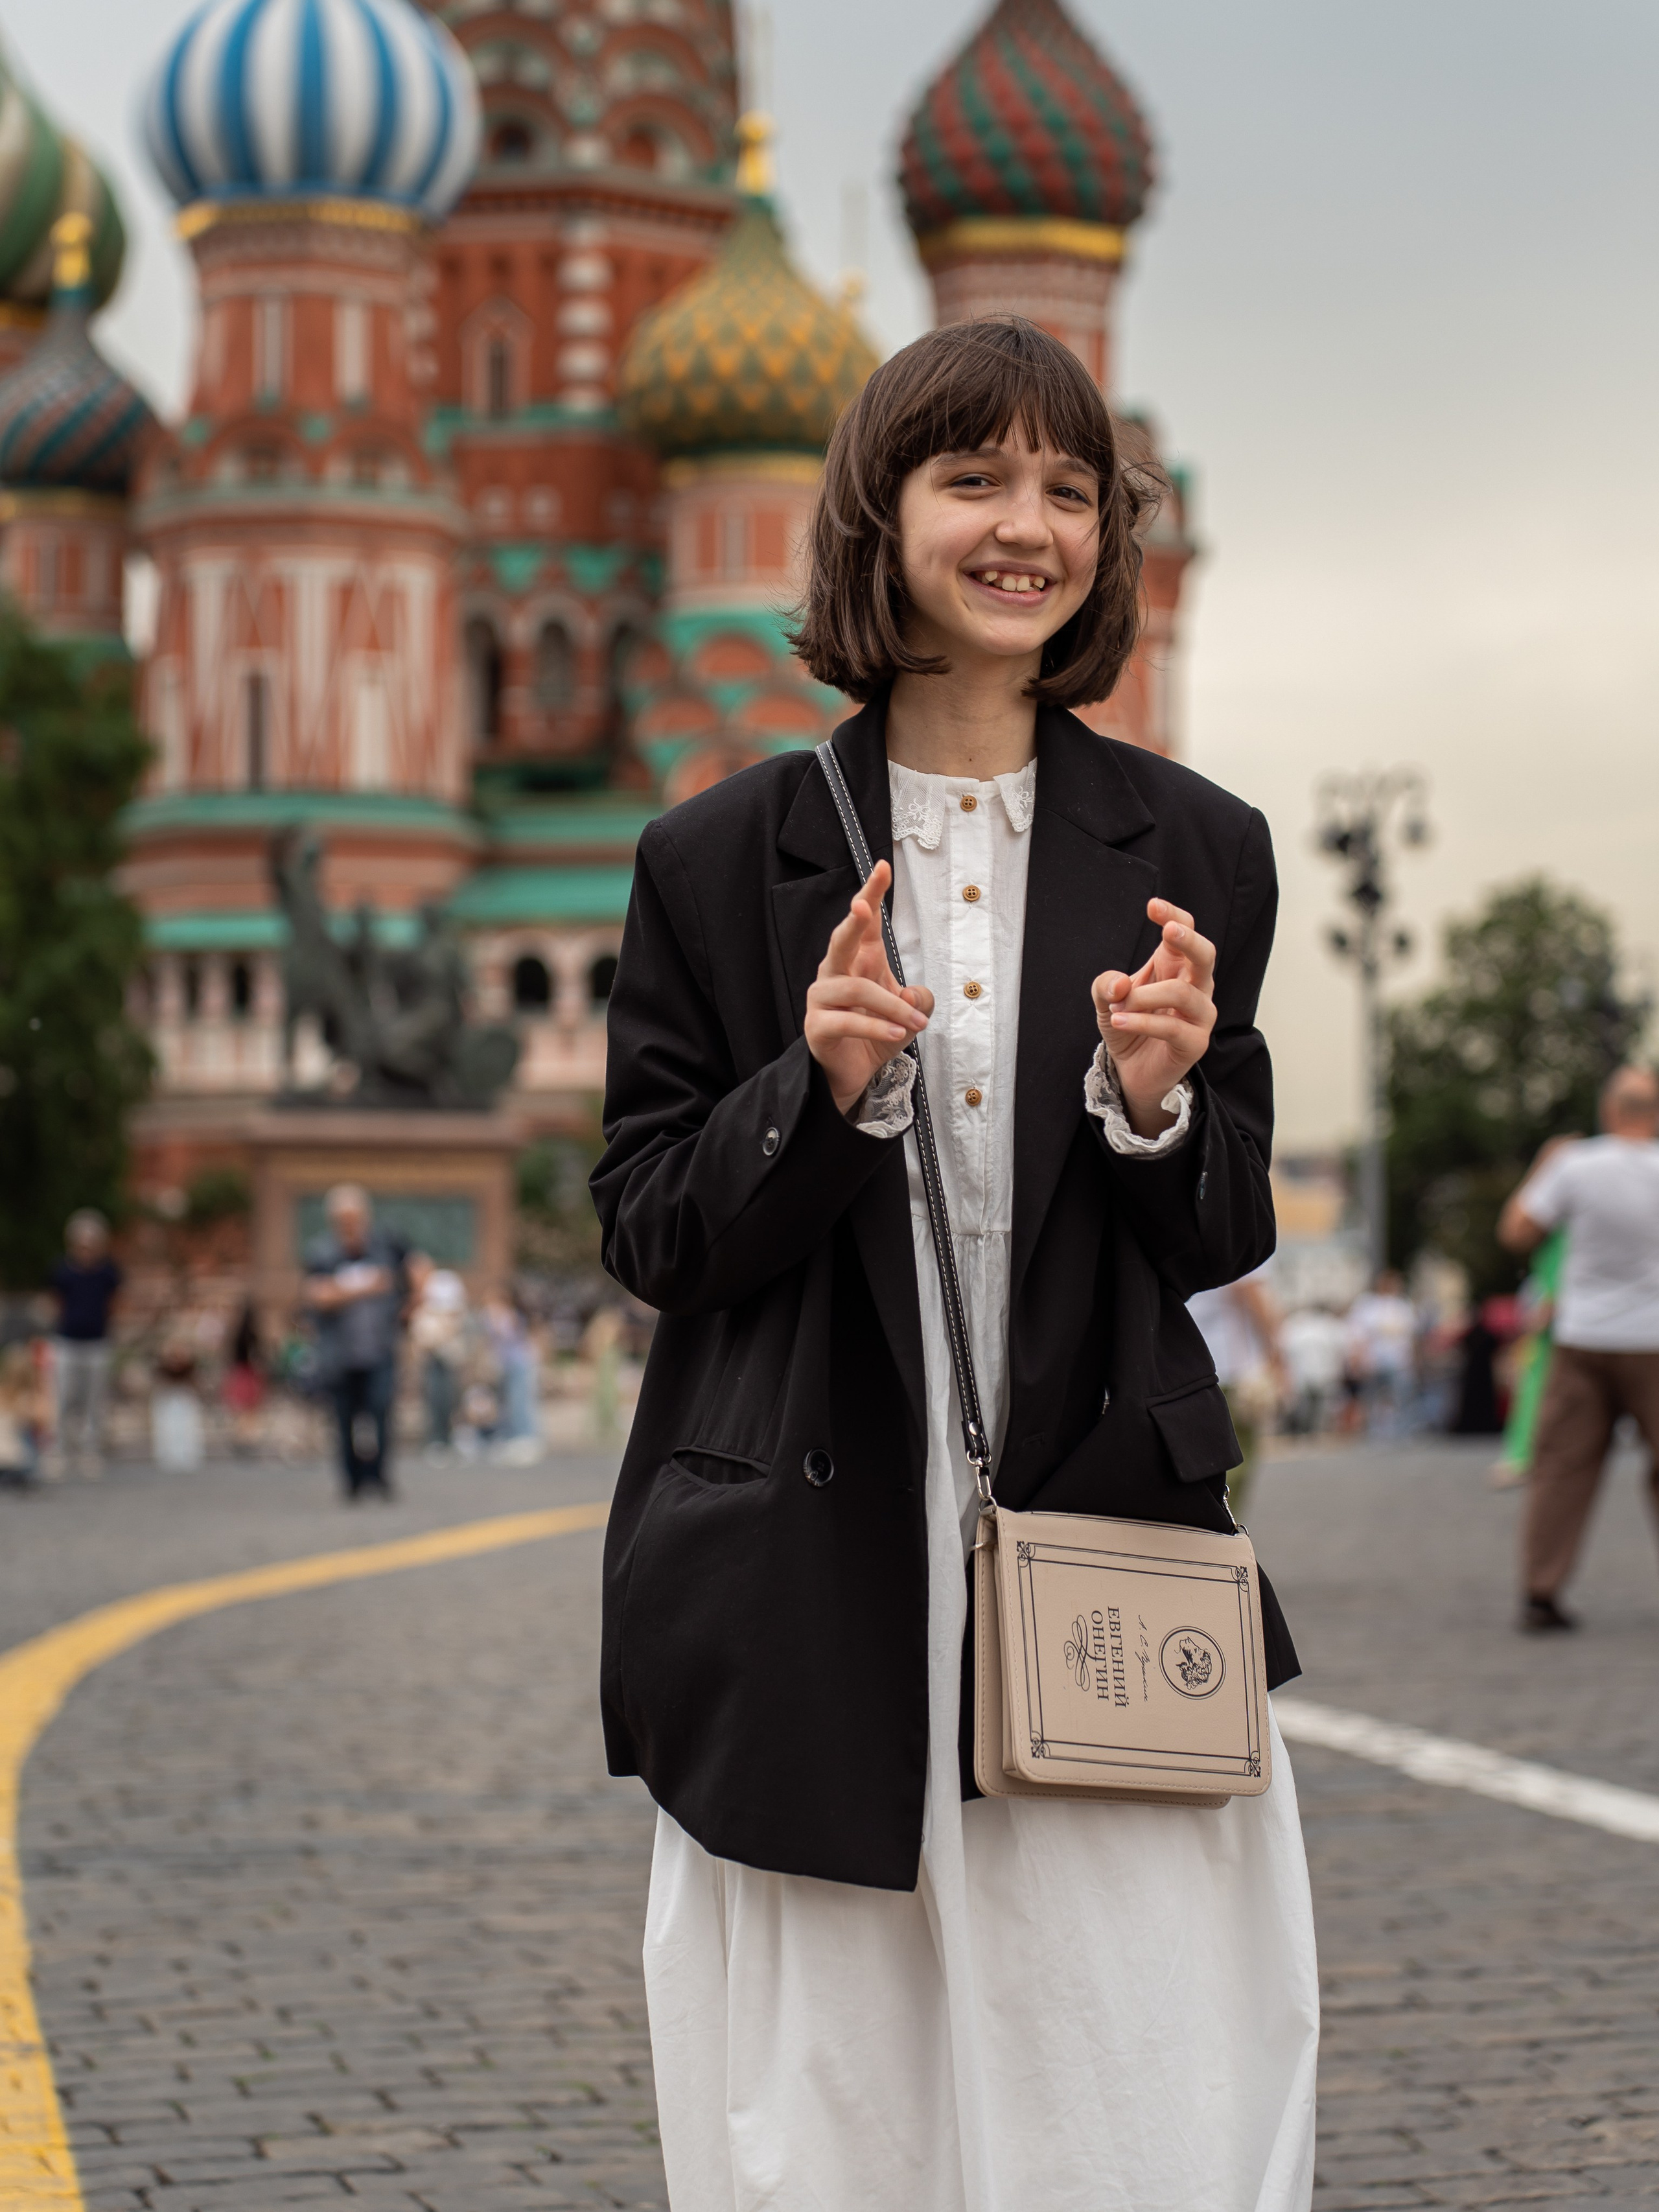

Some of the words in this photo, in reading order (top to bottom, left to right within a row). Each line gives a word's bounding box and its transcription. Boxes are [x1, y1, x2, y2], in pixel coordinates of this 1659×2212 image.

[1090, 1610, 1109, 1701] ОНЕГИН
[1107, 1605, 1130, 1708] ЕВГЕНИЙ
[1135, 1649, 1150, 1703] Пушкин
